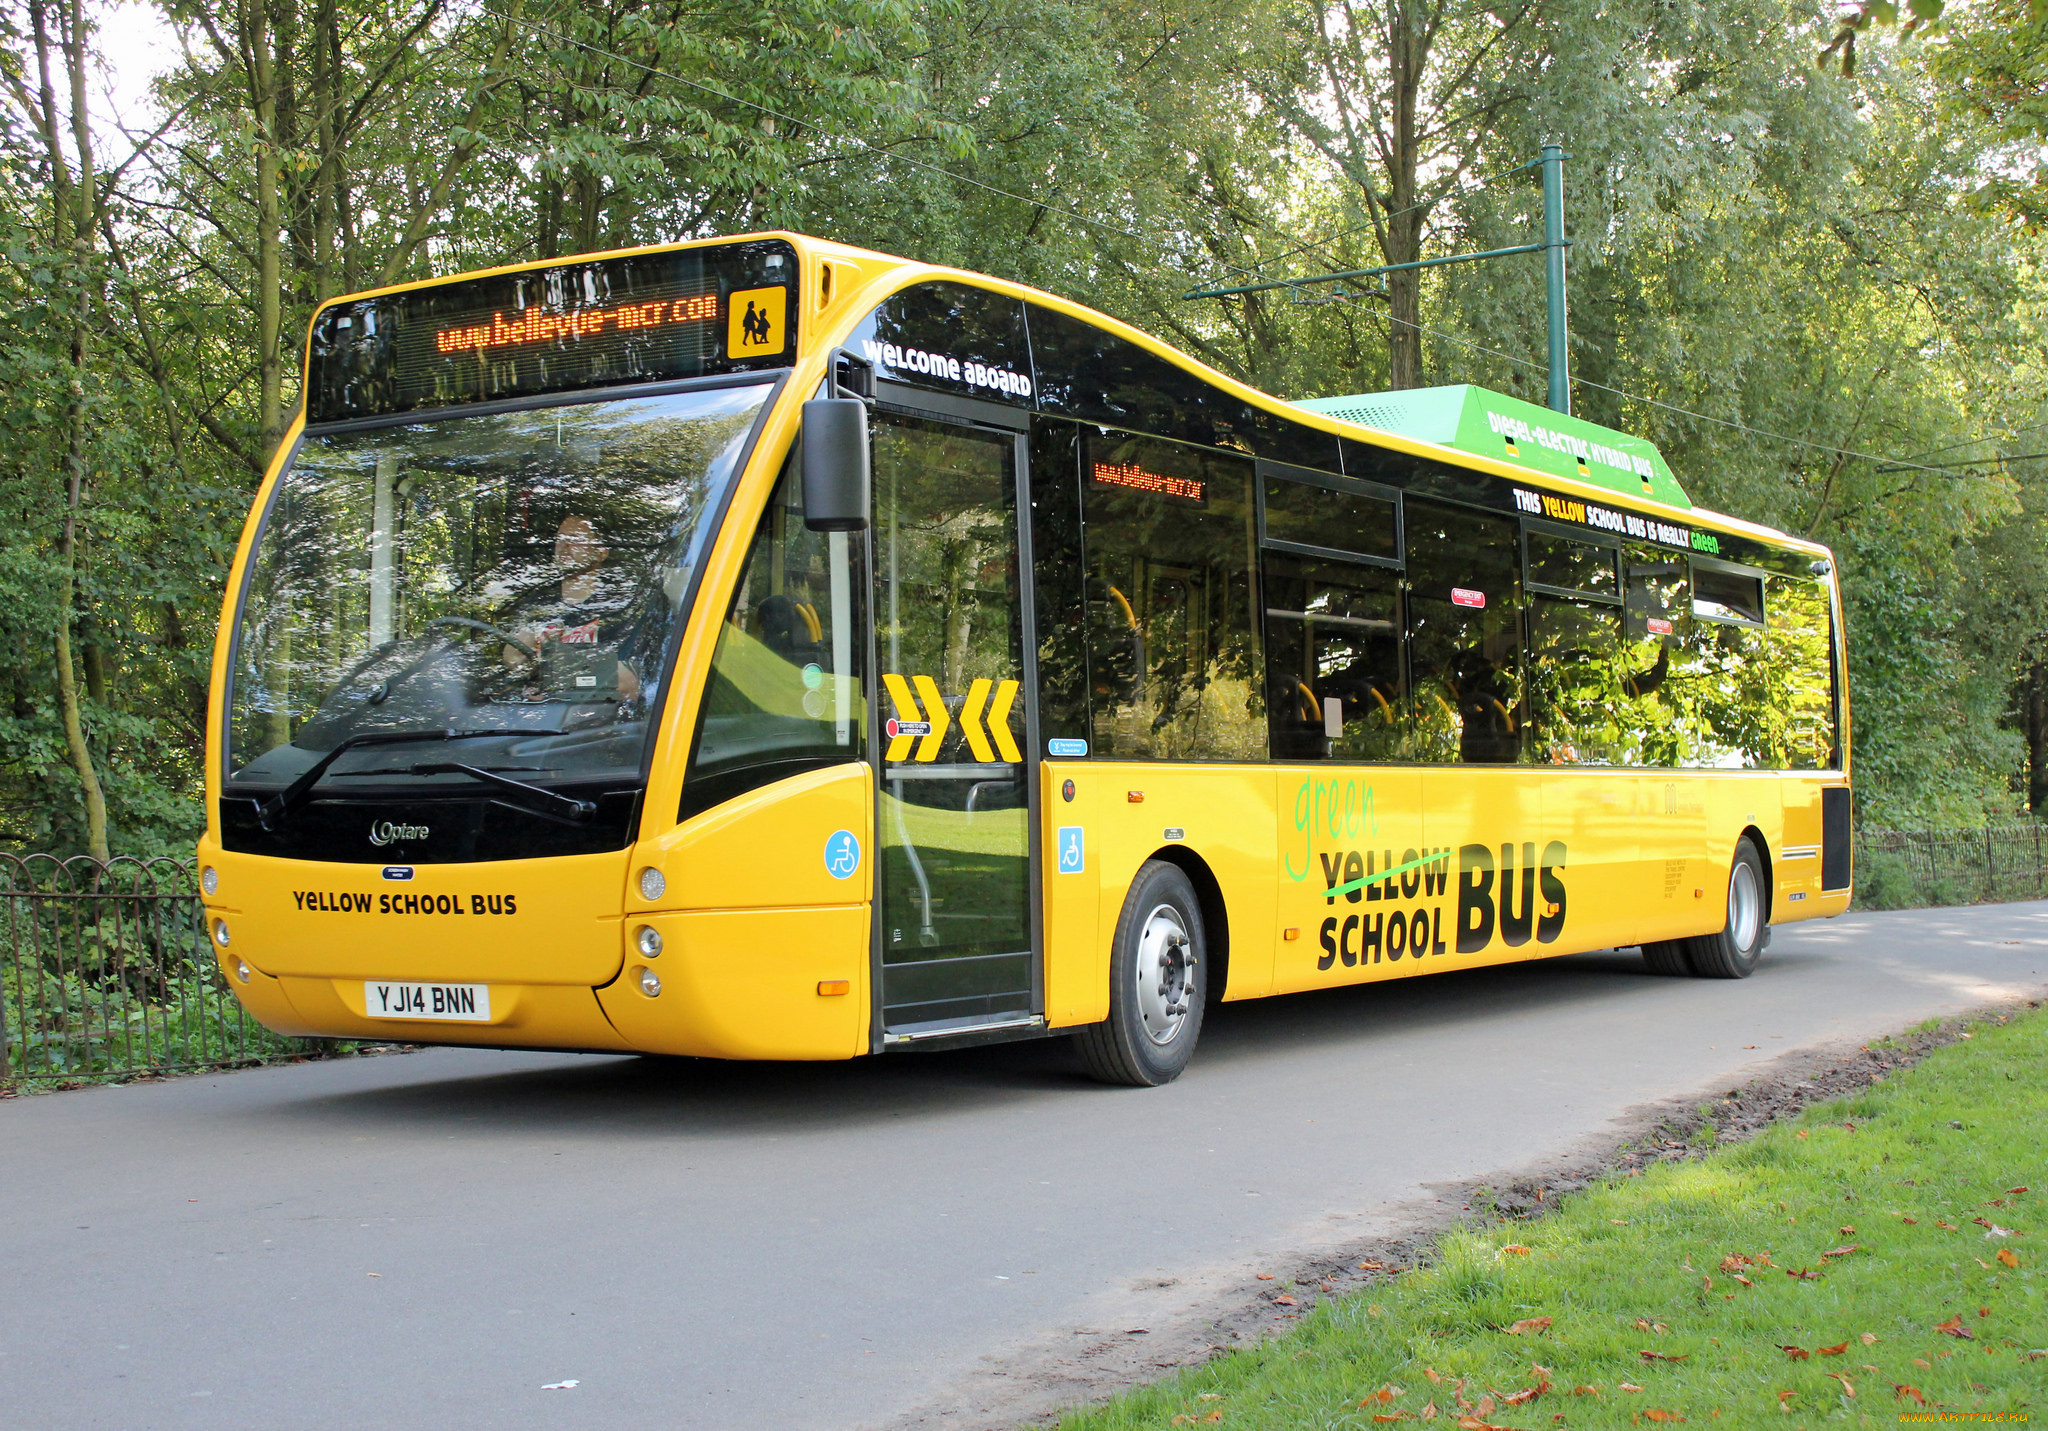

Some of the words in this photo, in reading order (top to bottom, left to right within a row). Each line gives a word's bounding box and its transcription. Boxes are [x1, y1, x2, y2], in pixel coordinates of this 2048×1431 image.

[1589, 442, 1632, 472] HYBRID
[1632, 455, 1654, 478] BUS
[1513, 488, 1541, 514] THIS
[1586, 505, 1627, 534] SCHOOL
[1626, 515, 1647, 538] BUS
[1647, 520, 1658, 540] IS
[378, 821, 430, 845] Optare
[1285, 774, 1378, 882] green
[380, 893, 464, 915] SCHOOL
[472, 895, 517, 916] BUS
[1456, 840, 1567, 954] BUS
[1317, 907, 1446, 971] SCHOOL
[378, 986, 425, 1012] YJ14
[431, 987, 475, 1013] BNN
